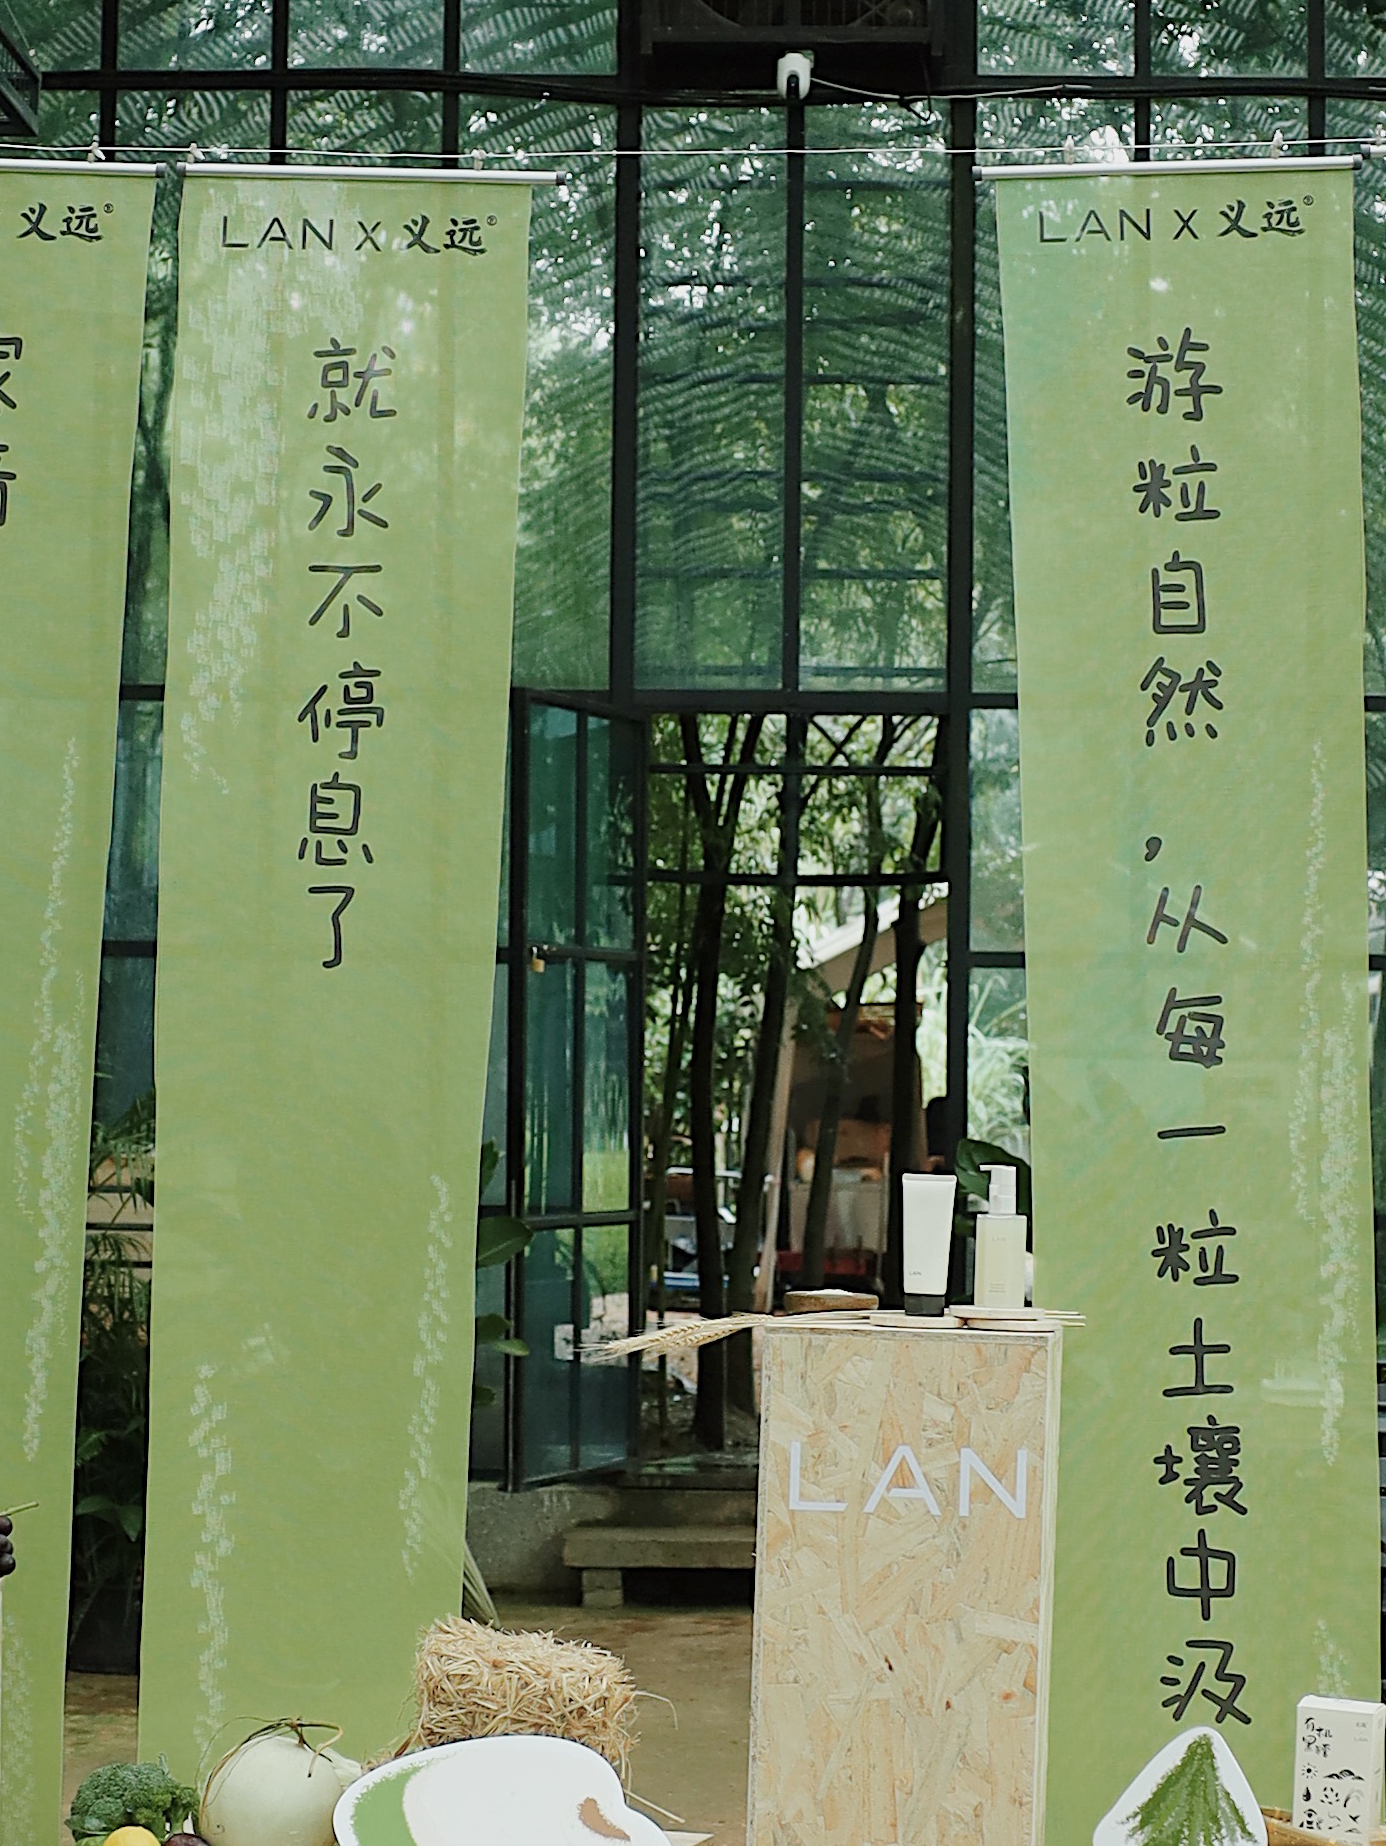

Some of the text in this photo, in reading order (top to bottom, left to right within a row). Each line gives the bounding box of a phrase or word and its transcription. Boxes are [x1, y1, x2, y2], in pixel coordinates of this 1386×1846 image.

[221, 215, 335, 252] LAN
[1038, 208, 1152, 244] LAN
[297, 337, 399, 969] 就永不停息了
[788, 1440, 1028, 1520] LAN
